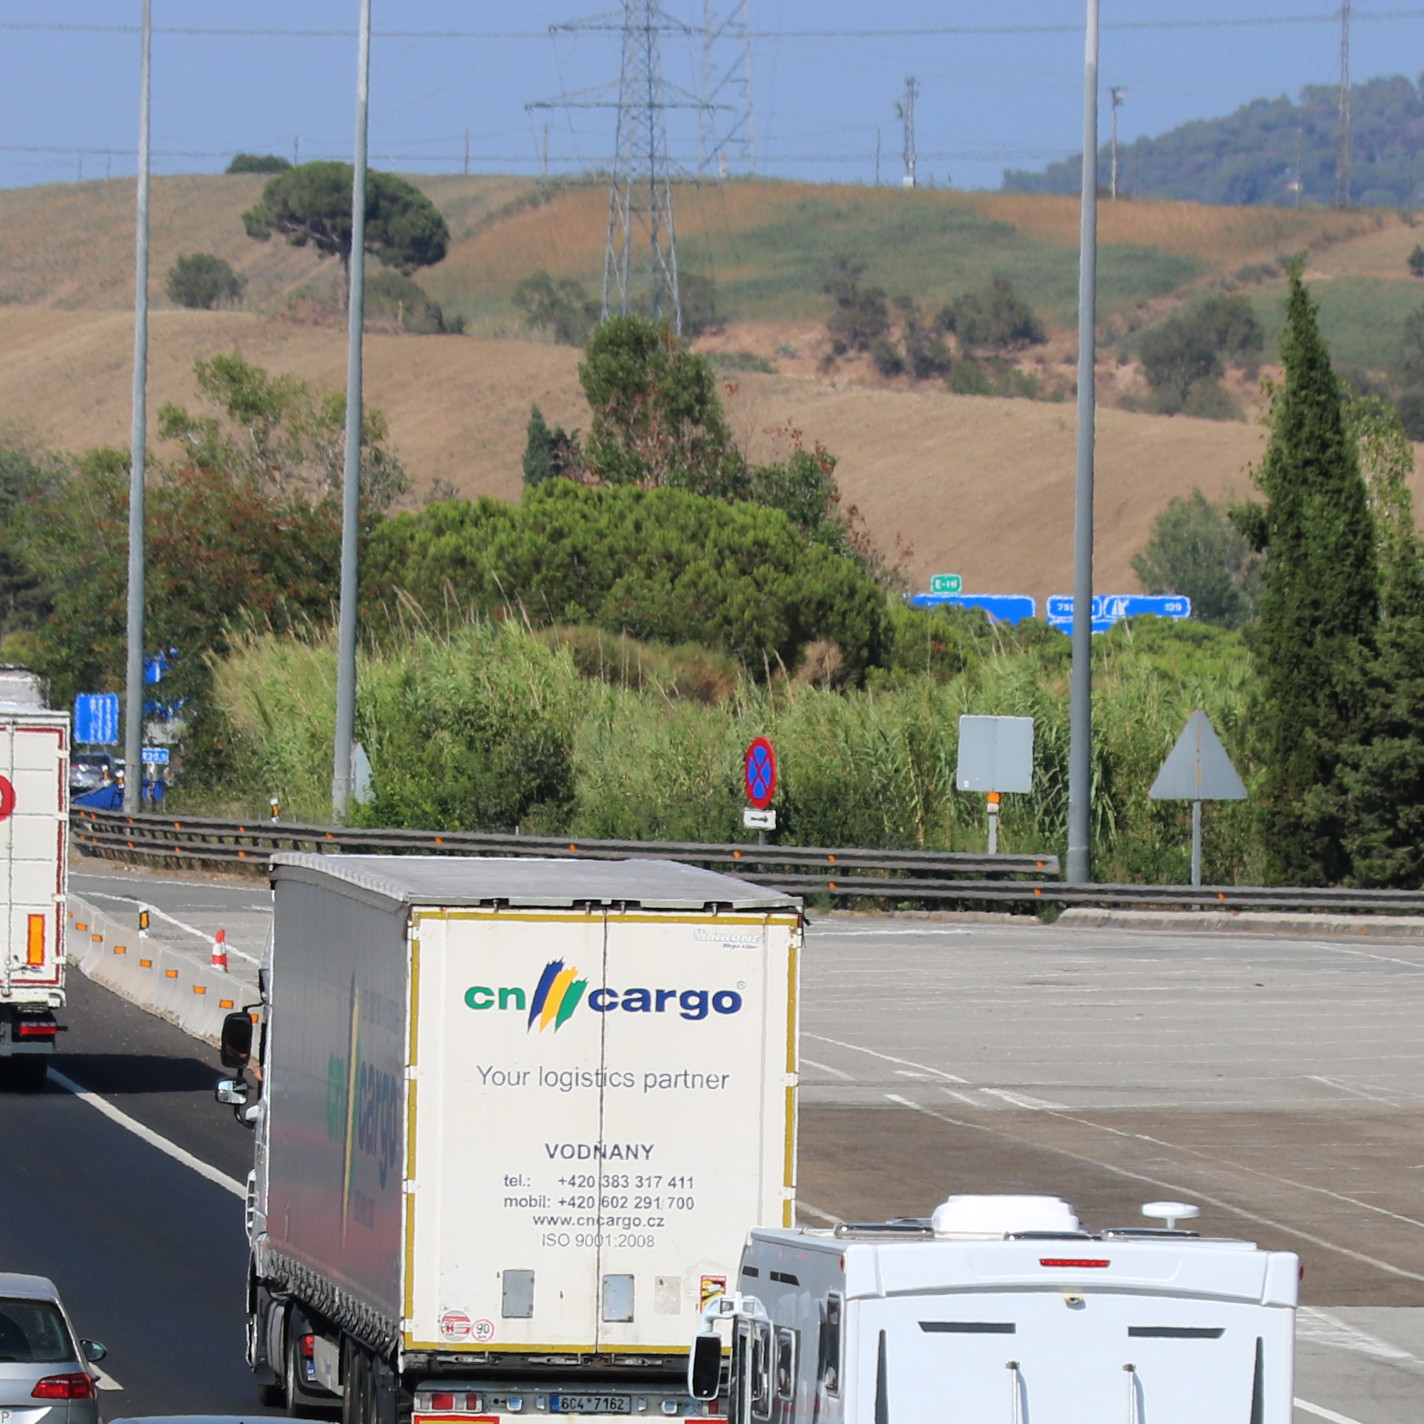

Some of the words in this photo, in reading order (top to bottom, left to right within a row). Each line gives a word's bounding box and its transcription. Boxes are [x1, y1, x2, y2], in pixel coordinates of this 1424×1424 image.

[464, 985, 526, 1010] cn
[588, 987, 742, 1021] cargo
[477, 1065, 530, 1086] Your
[539, 1066, 635, 1092] logistics
[644, 1069, 730, 1093] partner
[545, 1140, 655, 1161] VODŇANY
[504, 1174, 531, 1187] tel.:
[558, 1175, 595, 1188] +420
[602, 1175, 629, 1189] 383
[635, 1176, 663, 1189] 317
[668, 1176, 694, 1190] 411
[504, 1195, 551, 1208] mobil:
[558, 1196, 595, 1209] +420
[601, 1196, 629, 1209] 602
[634, 1196, 661, 1210] 291
[667, 1197, 695, 1210] 700
[533, 1215, 665, 1230] www.cncargo.cz
[542, 1233, 571, 1247] ISO
[575, 1234, 655, 1248] 9001:2008
[476, 1323, 490, 1335] 90
[595, 1397, 624, 1410] 7162
